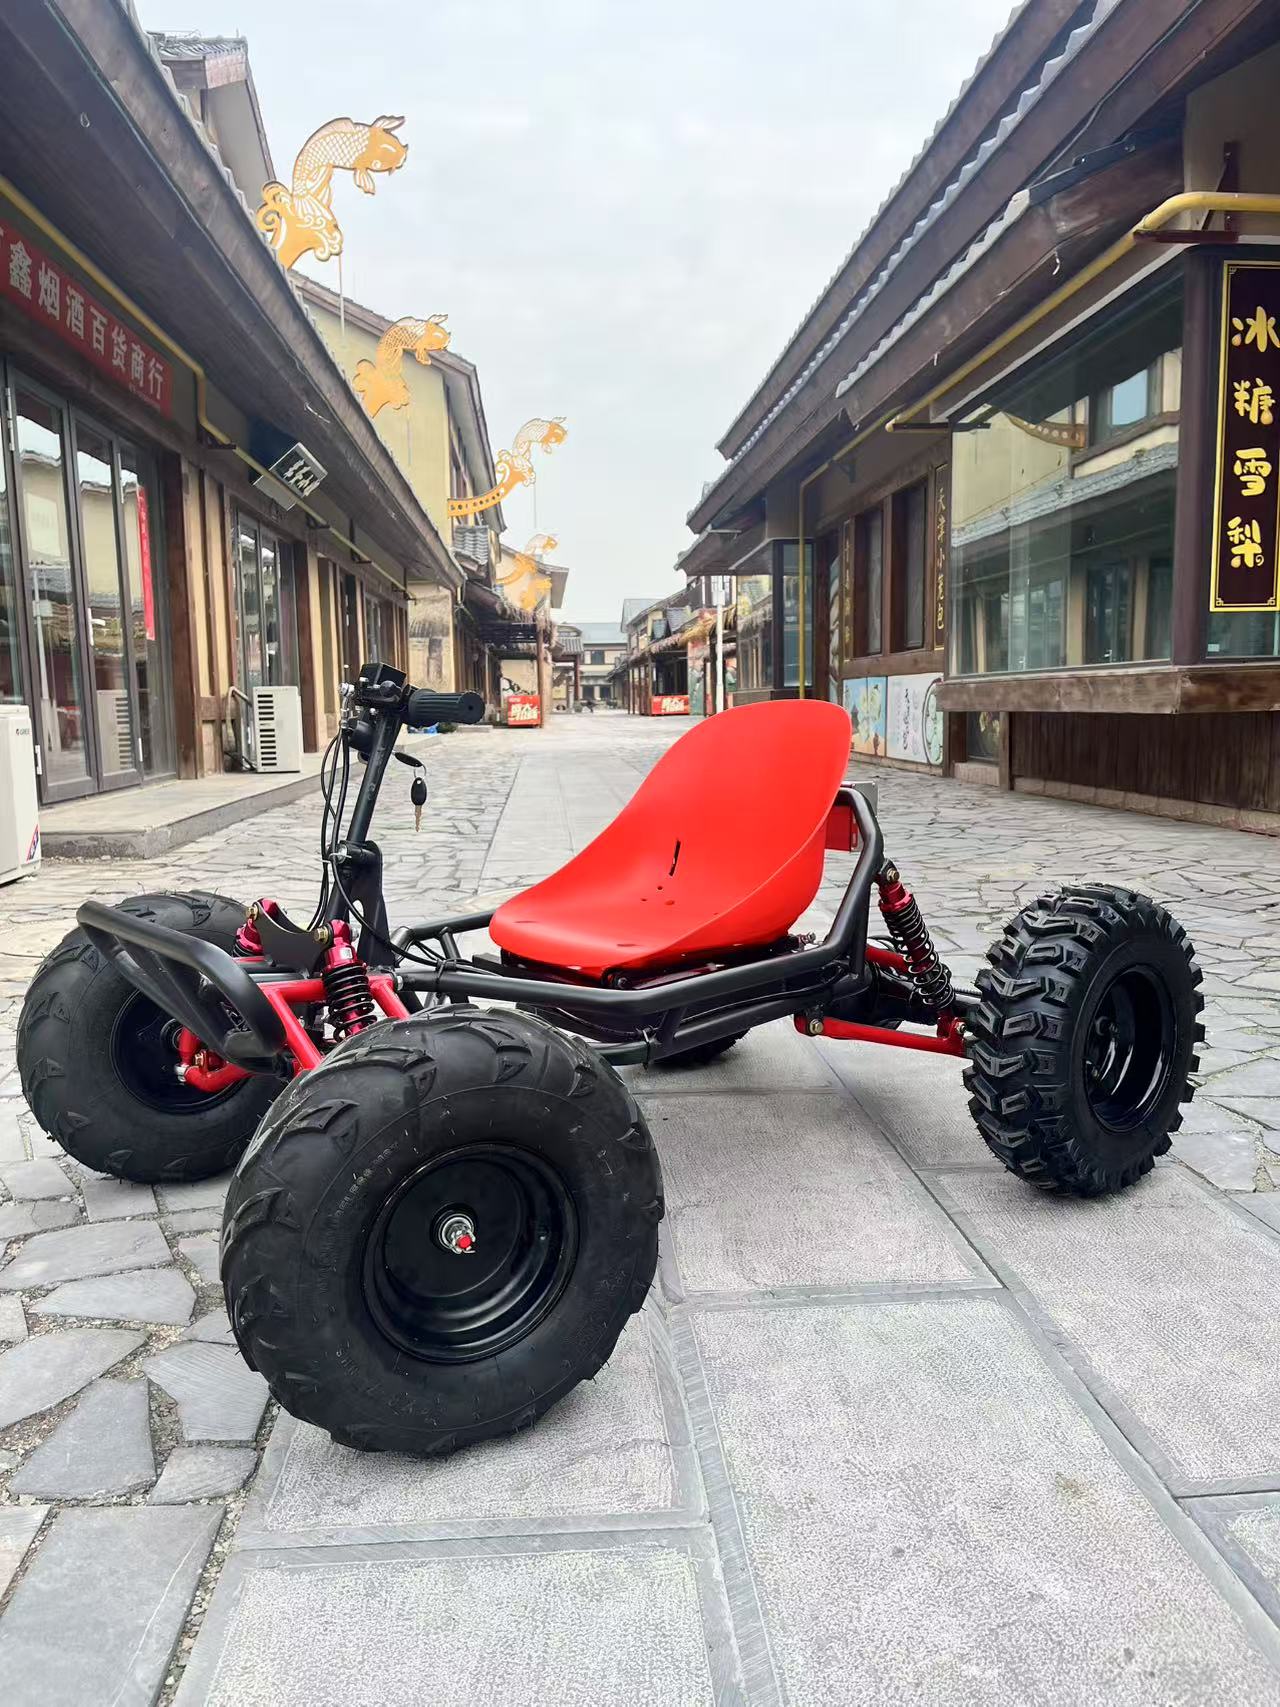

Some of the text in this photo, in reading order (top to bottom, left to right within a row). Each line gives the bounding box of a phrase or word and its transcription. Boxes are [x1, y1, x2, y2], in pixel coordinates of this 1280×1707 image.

[0, 228, 163, 400] 鑫烟酒百货商行
[1227, 306, 1280, 568] 冰糖雪梨
